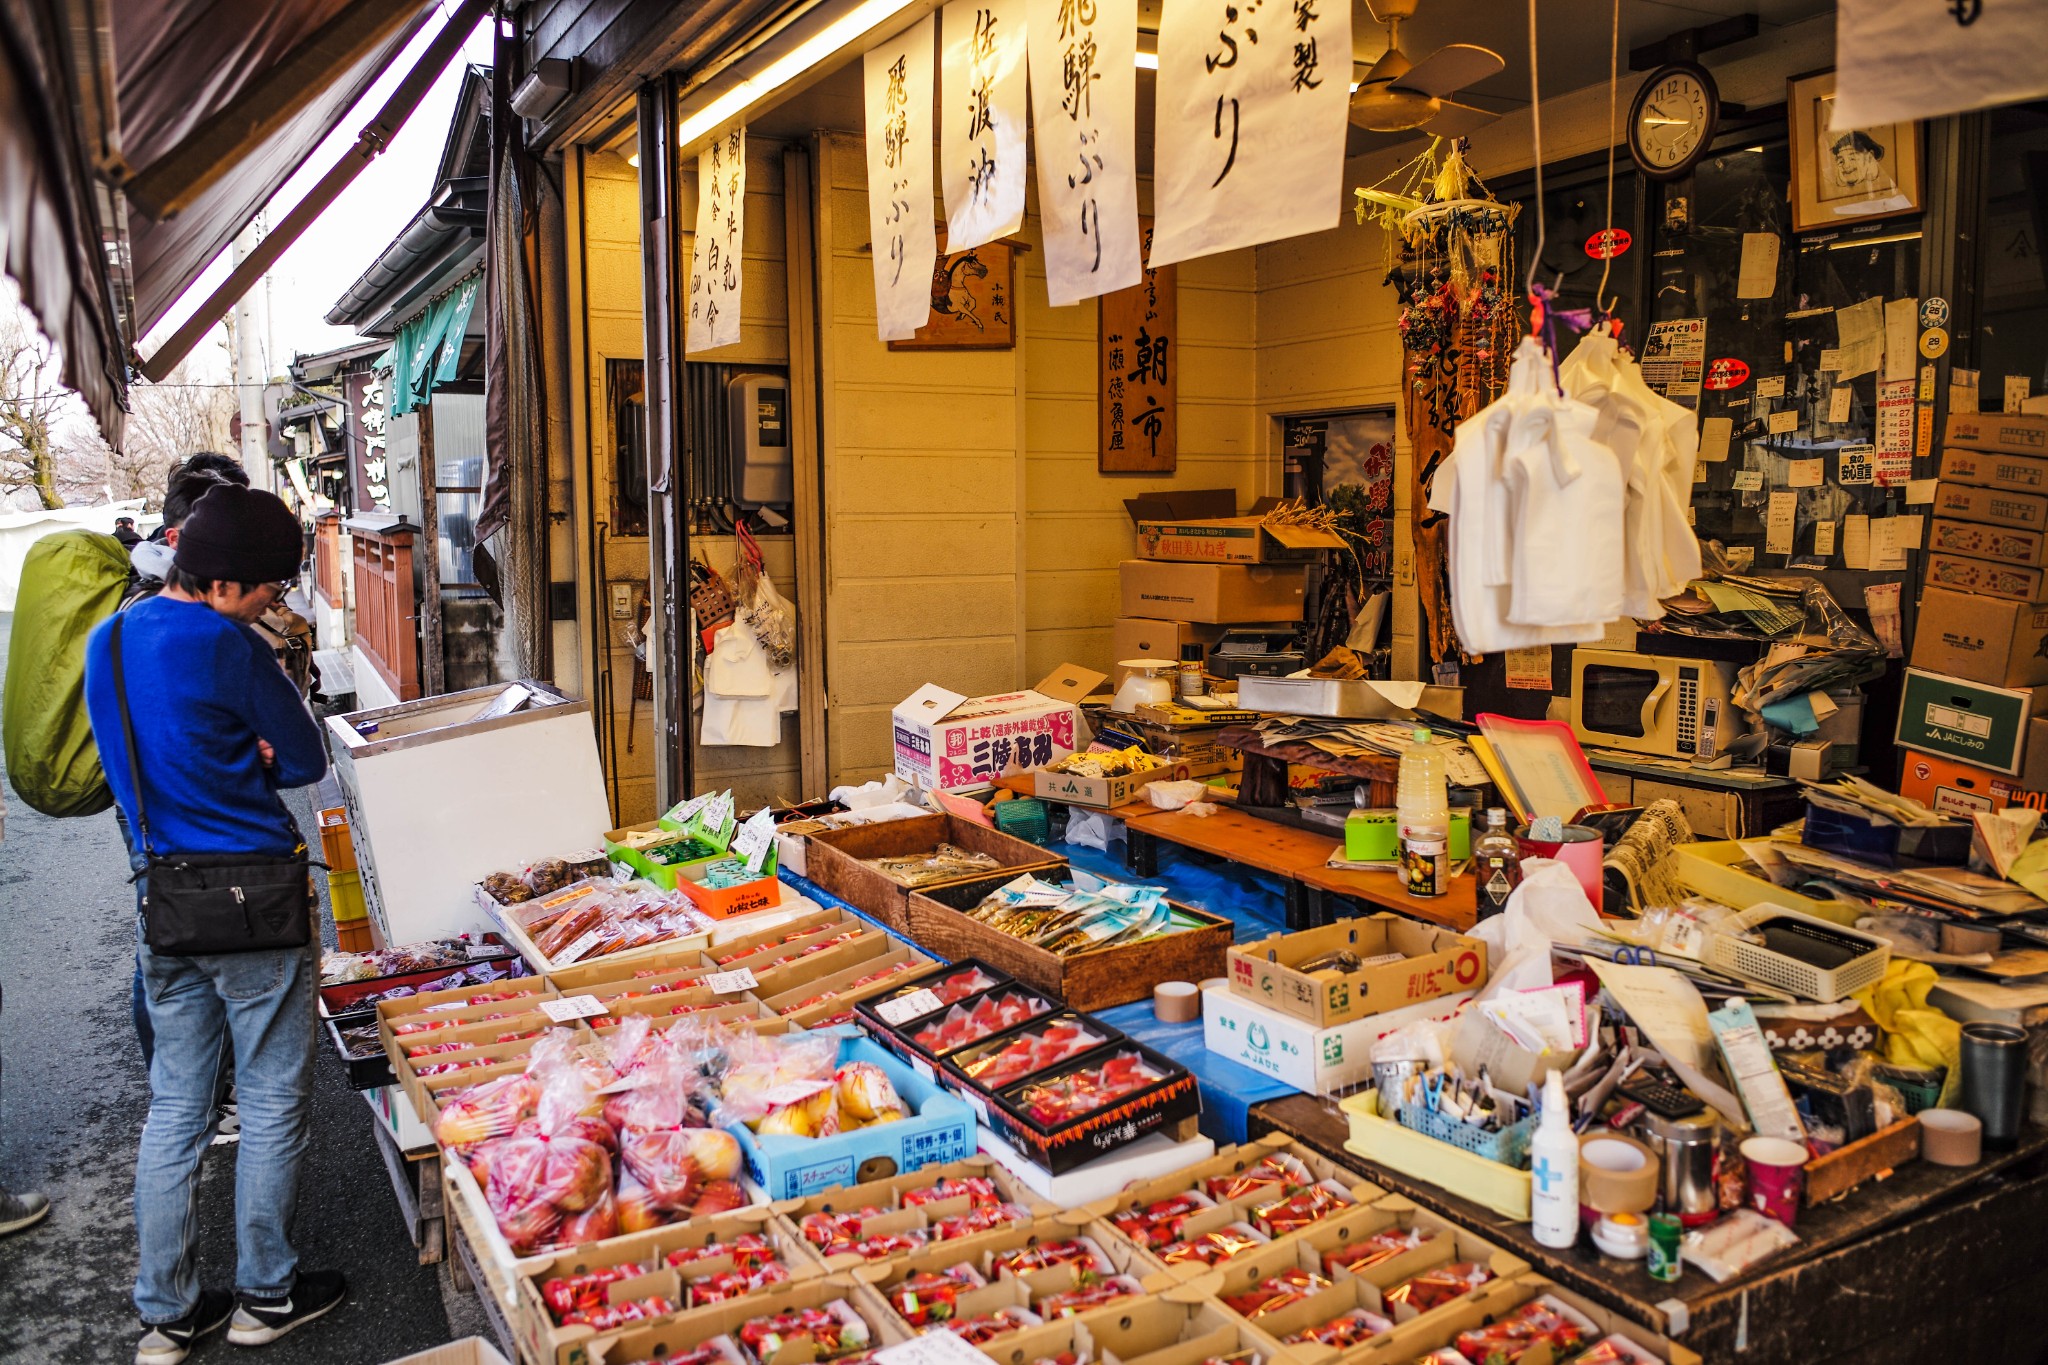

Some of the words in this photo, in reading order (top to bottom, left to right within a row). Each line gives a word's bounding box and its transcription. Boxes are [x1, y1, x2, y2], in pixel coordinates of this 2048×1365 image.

[1667, 80, 1678, 94] 12
[1684, 81, 1688, 94] 1
[1656, 88, 1664, 102] 11
[1693, 89, 1700, 103] 2
[968, 9, 998, 206] 佐渡沖
[1698, 106, 1704, 119] 3
[1646, 138, 1652, 151] 8
[1682, 141, 1689, 154] 5
[1656, 148, 1662, 161] 7
[1669, 148, 1676, 161] 6
[885, 54, 909, 288] 飛騨ぶり
[706, 237, 720, 343] 白い命
[991, 283, 1008, 325] 小瀬氏
[1928, 337, 1940, 346] 29
[1127, 326, 1168, 458] 朝市
[1899, 385, 1910, 394] 26
[1899, 409, 1910, 417] 27
[1899, 439, 1910, 447] 30
[1849, 454, 1865, 464] 食の
[1841, 463, 1873, 481] 安心宣言
[1161, 539, 1227, 557] 秋田美人ねぎ
[1059, 711, 1073, 724] Ca
[1943, 732, 1985, 750] JAにしみの
[952, 765, 965, 776] Ca
[954, 776, 968, 787] Ca
[726, 896, 770, 915] 山椒七味
[1219, 1016, 1236, 1031] 安全
[1280, 1040, 1299, 1056] 安心
[802, 1164, 850, 1185] スチューベン
